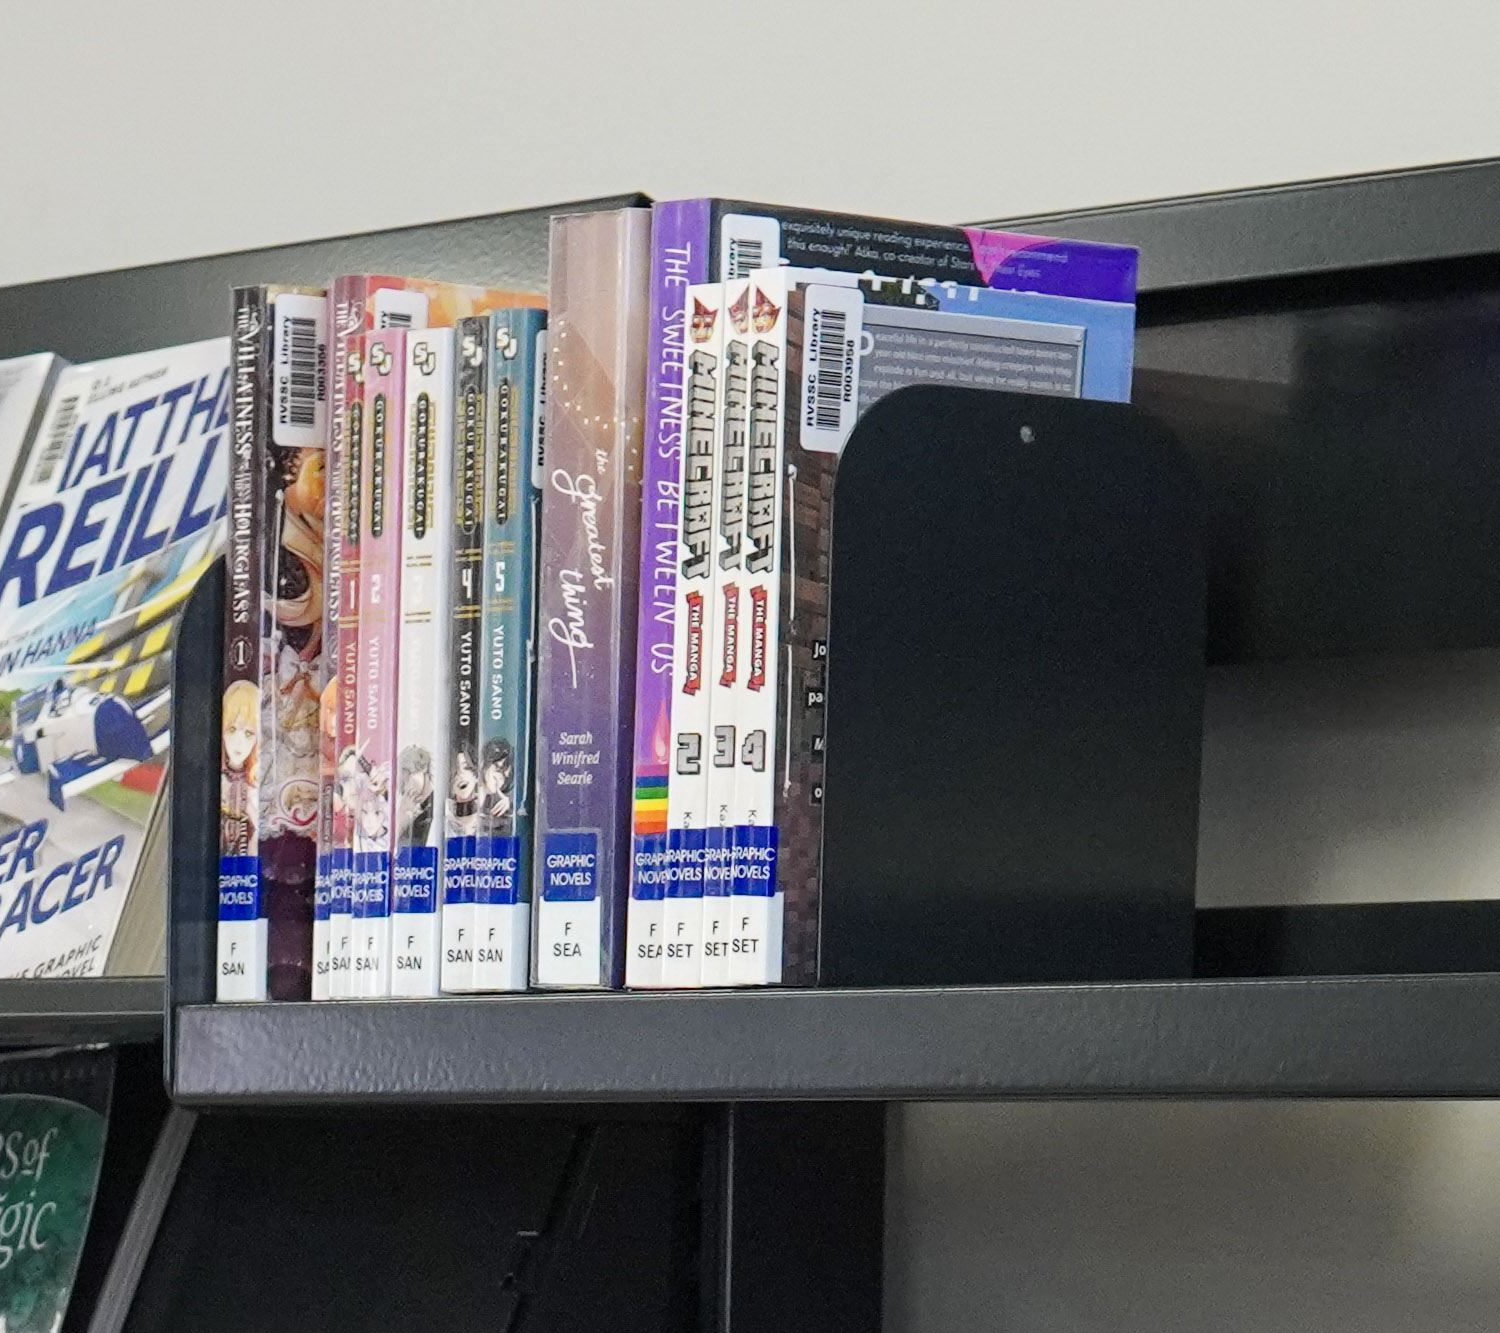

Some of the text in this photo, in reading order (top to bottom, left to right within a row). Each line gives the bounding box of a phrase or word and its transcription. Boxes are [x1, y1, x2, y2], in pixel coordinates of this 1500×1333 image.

[807, 308, 822, 427] RVSSC Library
[844, 339, 856, 402] R003958
[650, 242, 691, 677] THE SWEETNESS BETWEEN US
[682, 350, 718, 681] MINECRAFT THE MANGA
[233, 503, 254, 624] HOURGLASS
[461, 568, 473, 598] 4
[494, 562, 505, 591] 5
[549, 449, 616, 688] the Greatest thing
[21, 617, 98, 667] HANNA
[235, 641, 247, 666] 1
[458, 632, 473, 727] YUTO SANO
[551, 750, 600, 766] Winifred
[559, 731, 593, 746] Sarah
[676, 733, 702, 775] 2
[557, 770, 593, 786] Searle
[547, 854, 596, 869] GRAPHIC
[550, 871, 592, 886] NOVELS
[553, 943, 582, 957] SEA
[22, 1127, 59, 1182] of
